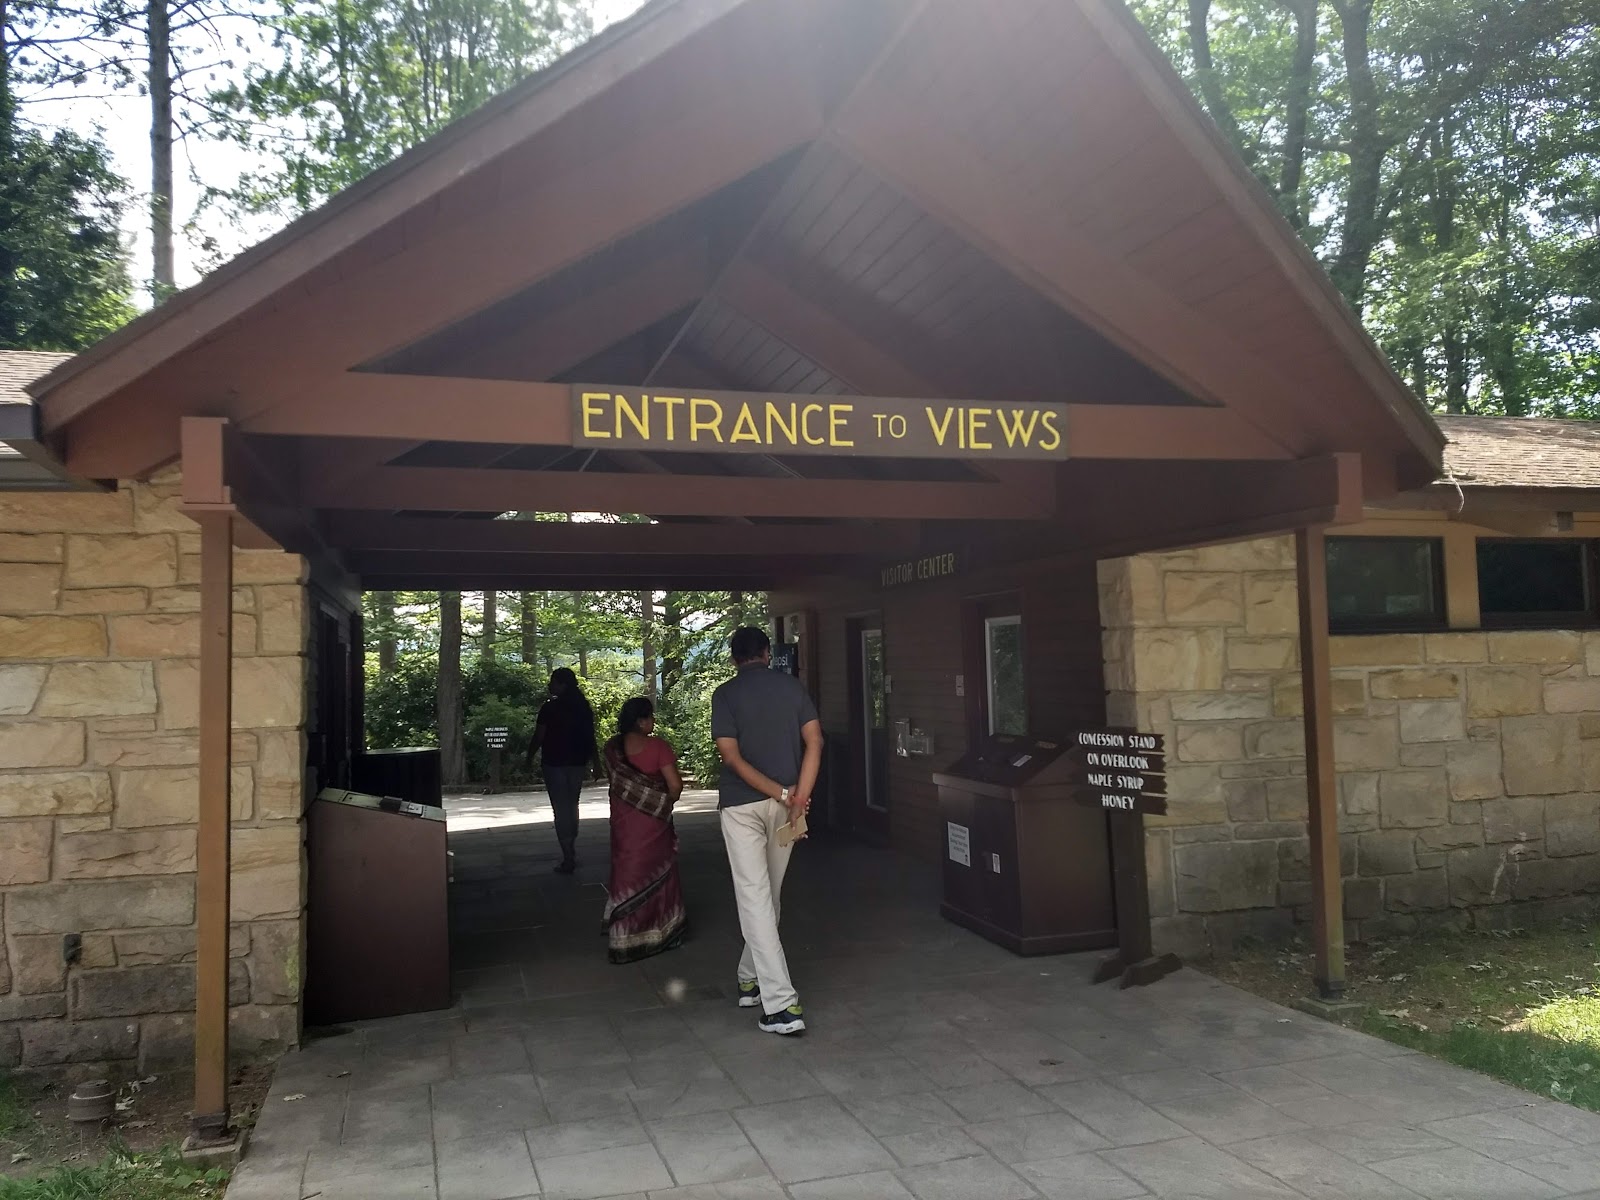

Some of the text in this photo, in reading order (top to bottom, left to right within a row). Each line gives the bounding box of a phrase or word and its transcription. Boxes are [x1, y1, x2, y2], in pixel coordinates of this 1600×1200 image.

[581, 393, 1061, 451] ENTRANCE TO VIEWS
[880, 552, 954, 586] VISITOR CENTER
[1078, 732, 1156, 749] CONCESSION STAND
[1087, 752, 1149, 769] ON OVERLOOK
[1088, 773, 1144, 790] MAPLE SYRUP
[1101, 794, 1135, 810] HONEY
